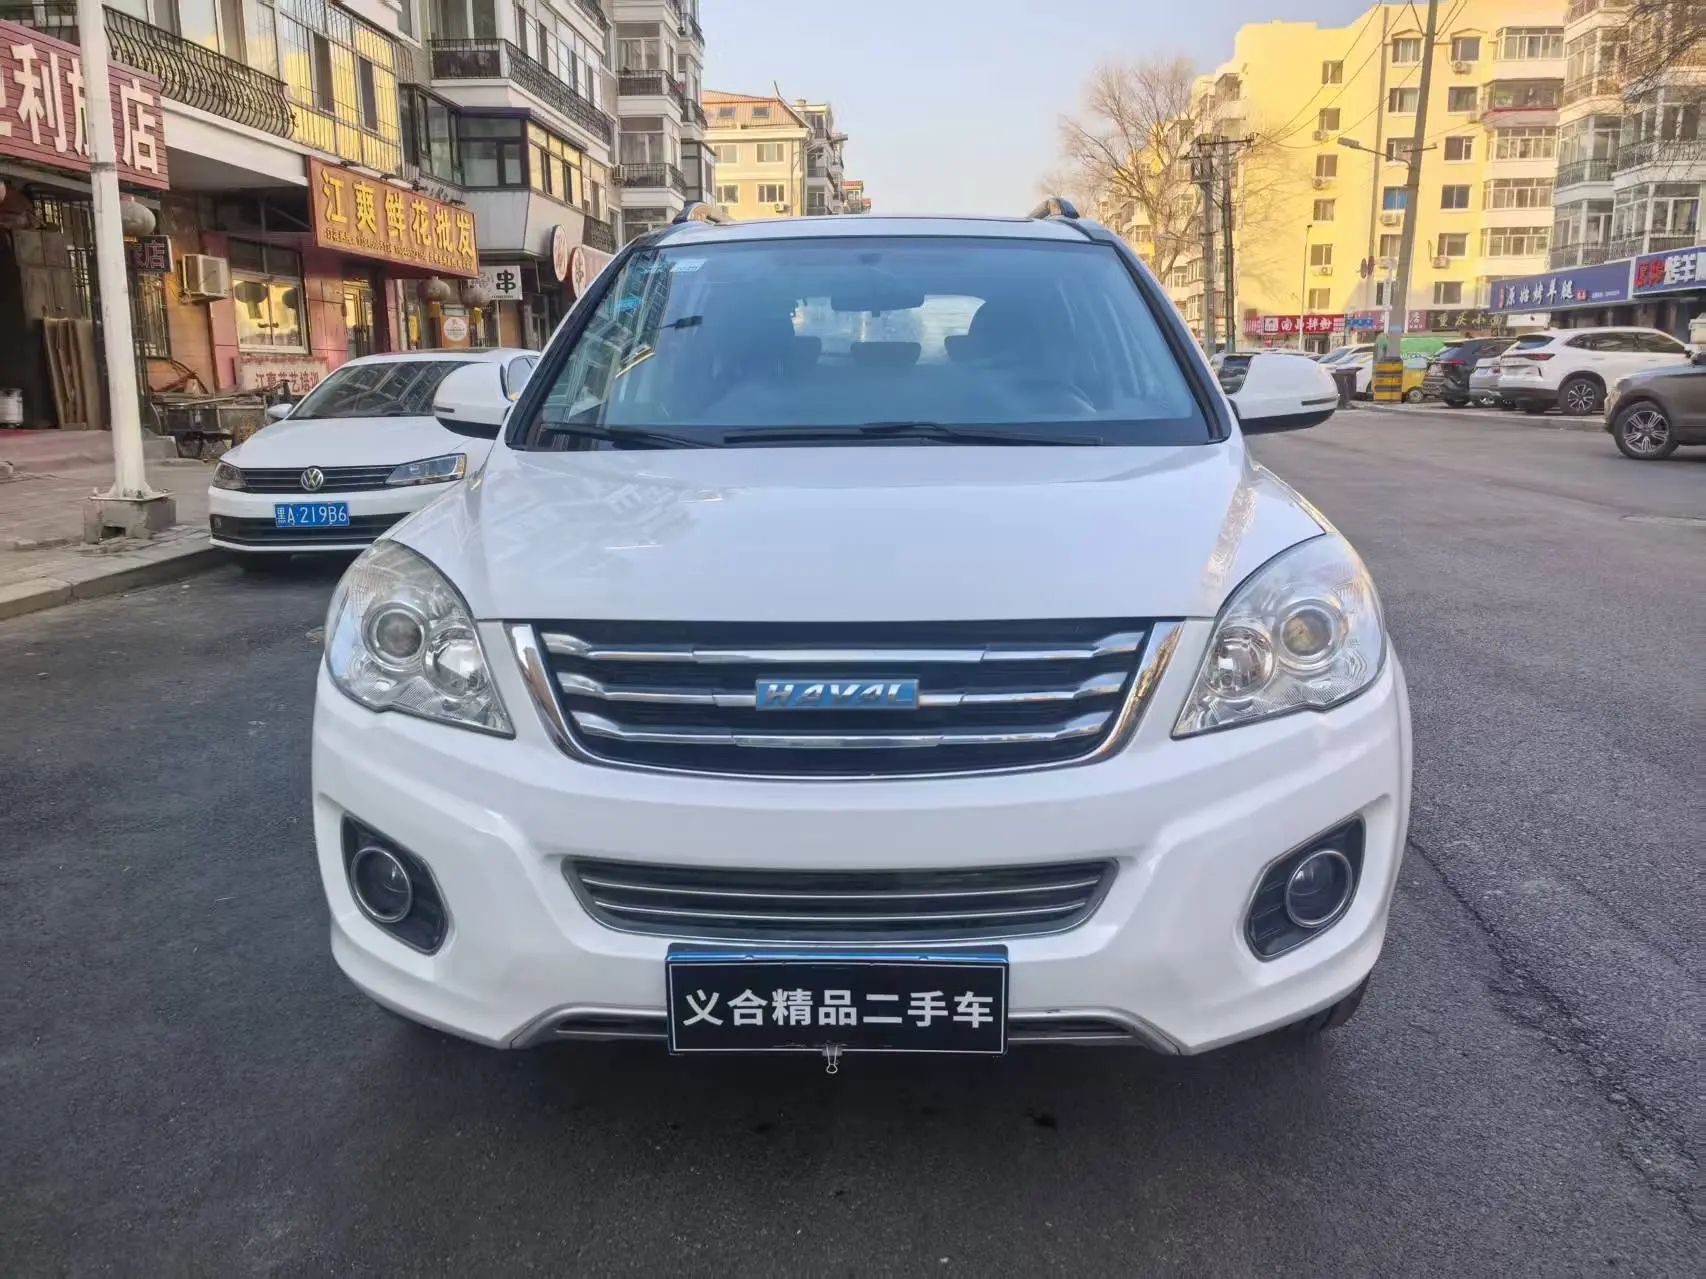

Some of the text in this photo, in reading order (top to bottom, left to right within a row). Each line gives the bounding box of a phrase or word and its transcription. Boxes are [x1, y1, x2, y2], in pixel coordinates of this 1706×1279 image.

[319, 166, 473, 256] 江爽鲜花批发
[496, 269, 516, 294] 串
[765, 684, 913, 706] HAVAL
[683, 988, 994, 1029] 义合精品二手车
